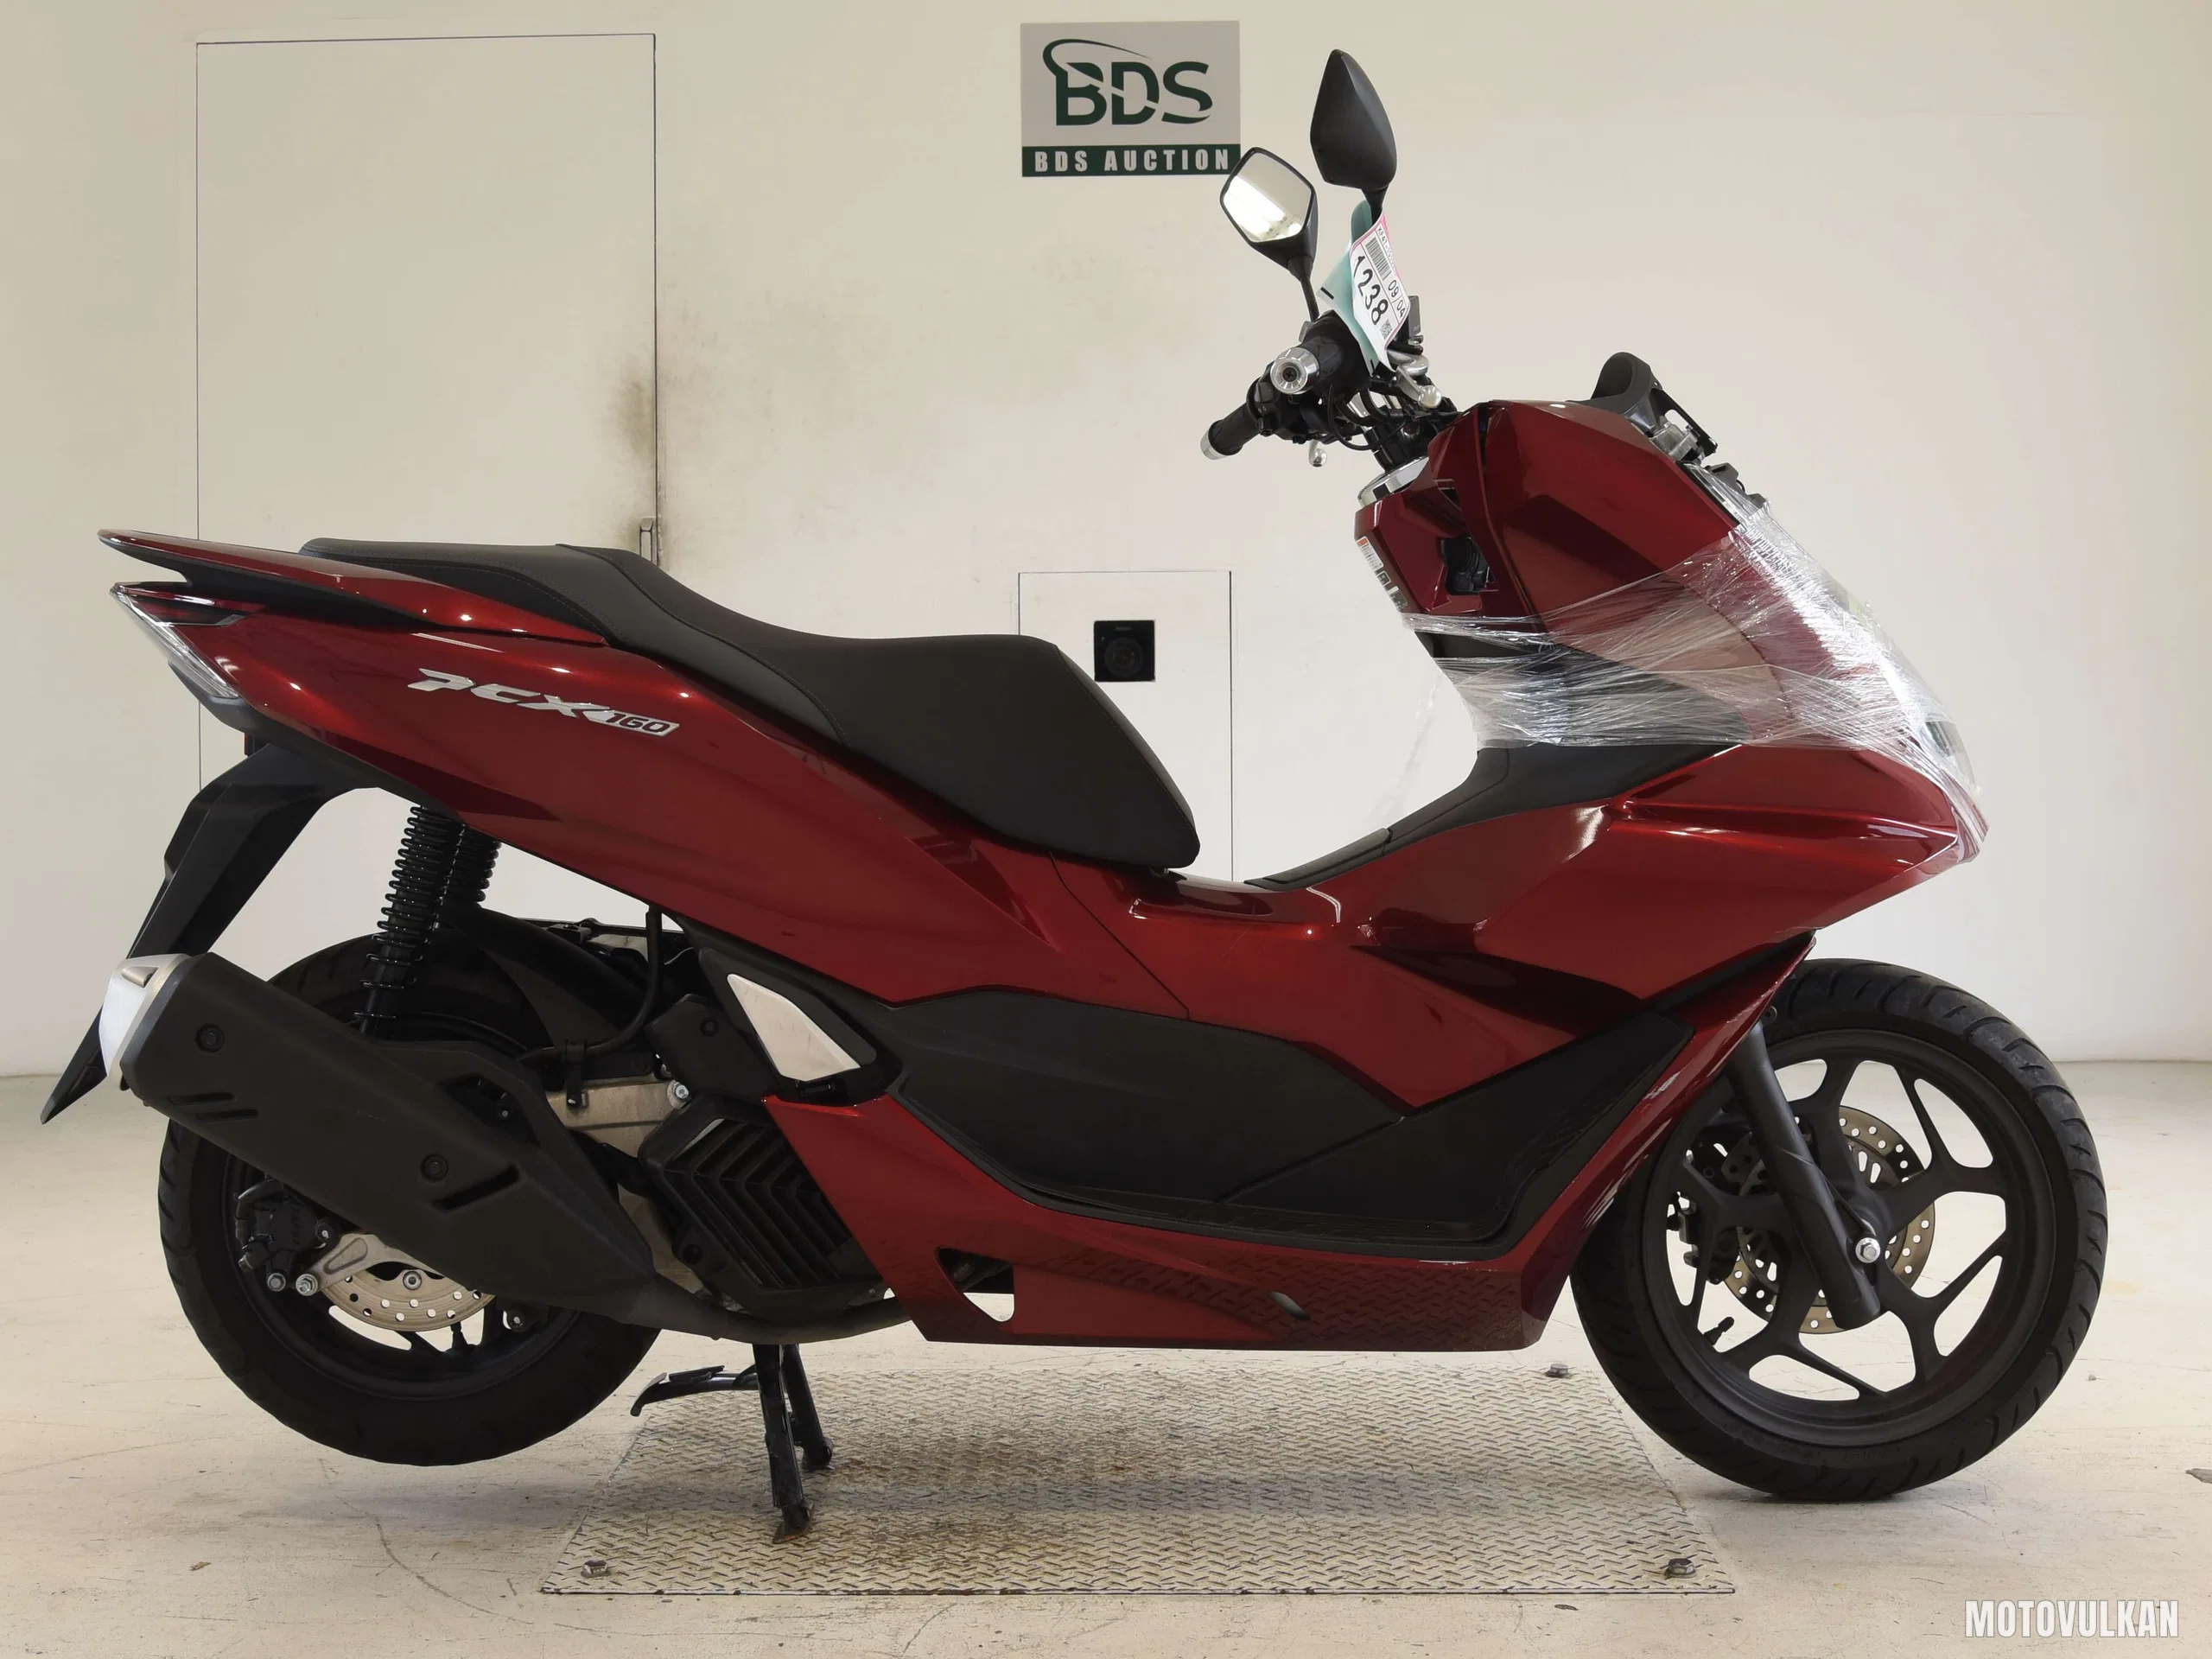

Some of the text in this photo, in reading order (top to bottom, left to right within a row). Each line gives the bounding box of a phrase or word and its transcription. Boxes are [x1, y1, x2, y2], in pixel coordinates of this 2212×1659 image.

[1052, 60, 1214, 126] BDS
[1034, 148, 1229, 173] BDS AUCTION
[1353, 256, 1389, 326] 1238
[407, 668, 671, 734] PCX 160
